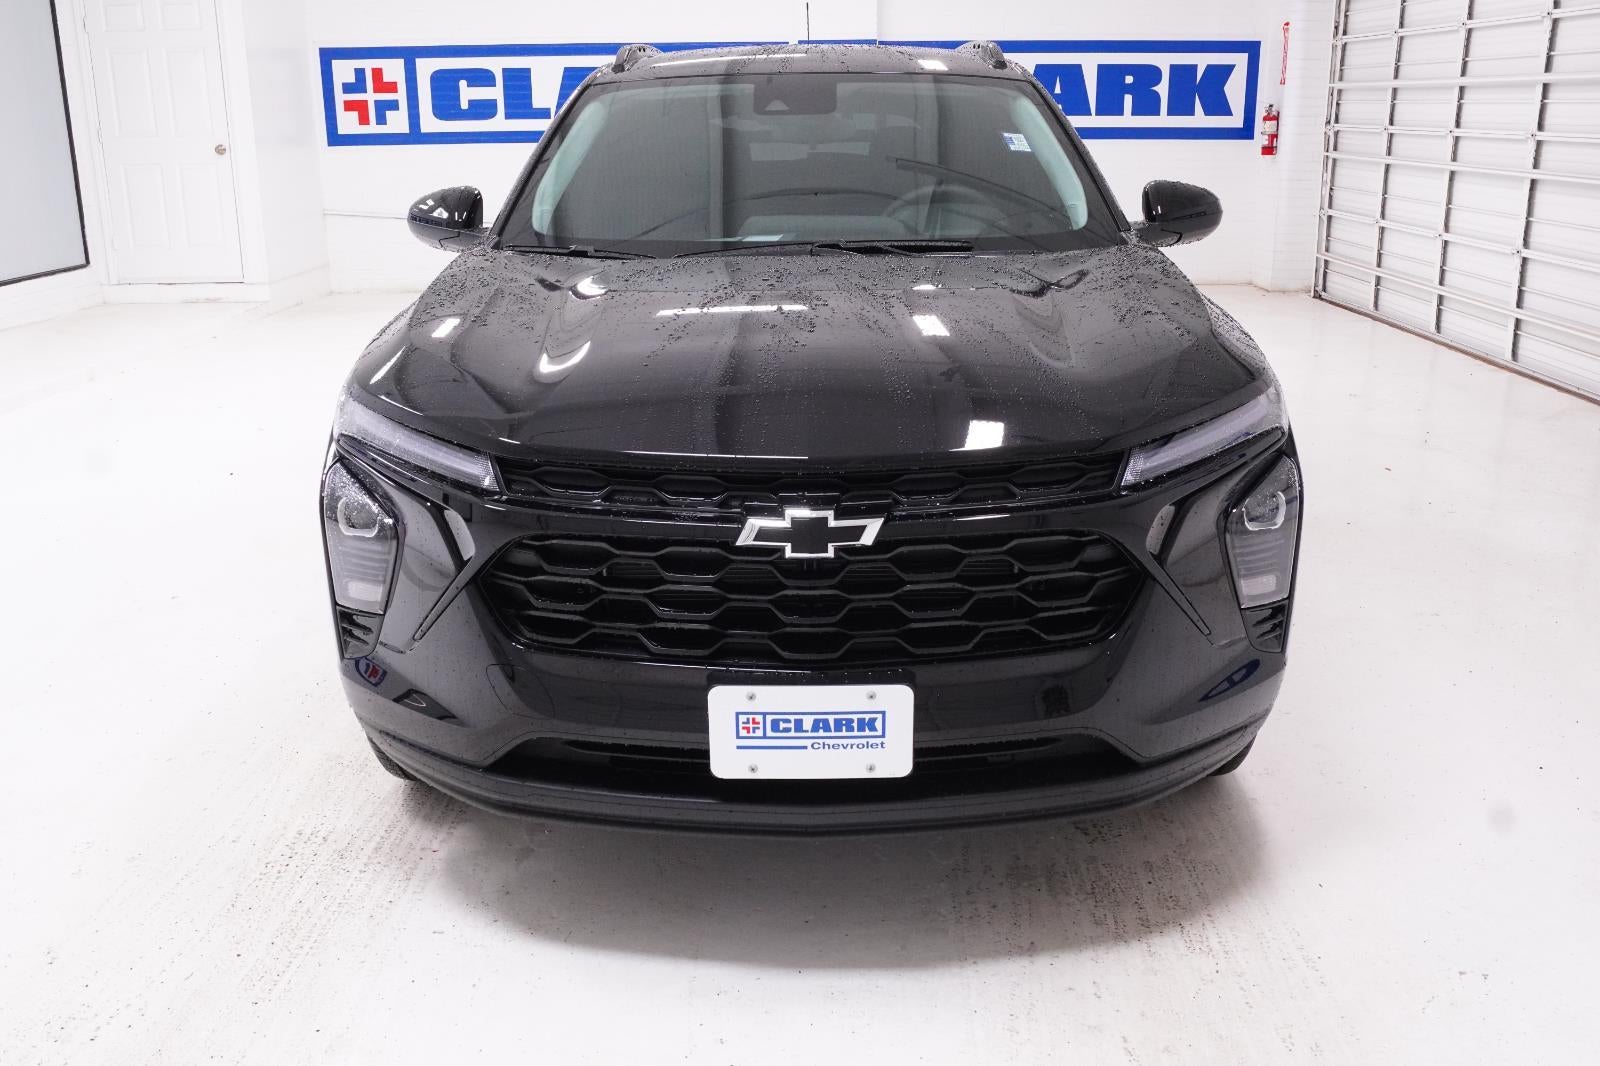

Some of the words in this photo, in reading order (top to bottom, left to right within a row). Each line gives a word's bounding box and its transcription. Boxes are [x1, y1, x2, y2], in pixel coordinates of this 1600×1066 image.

[430, 67, 599, 121] CL
[770, 716, 879, 734] CLARK
[810, 740, 886, 751] Chevrolet
